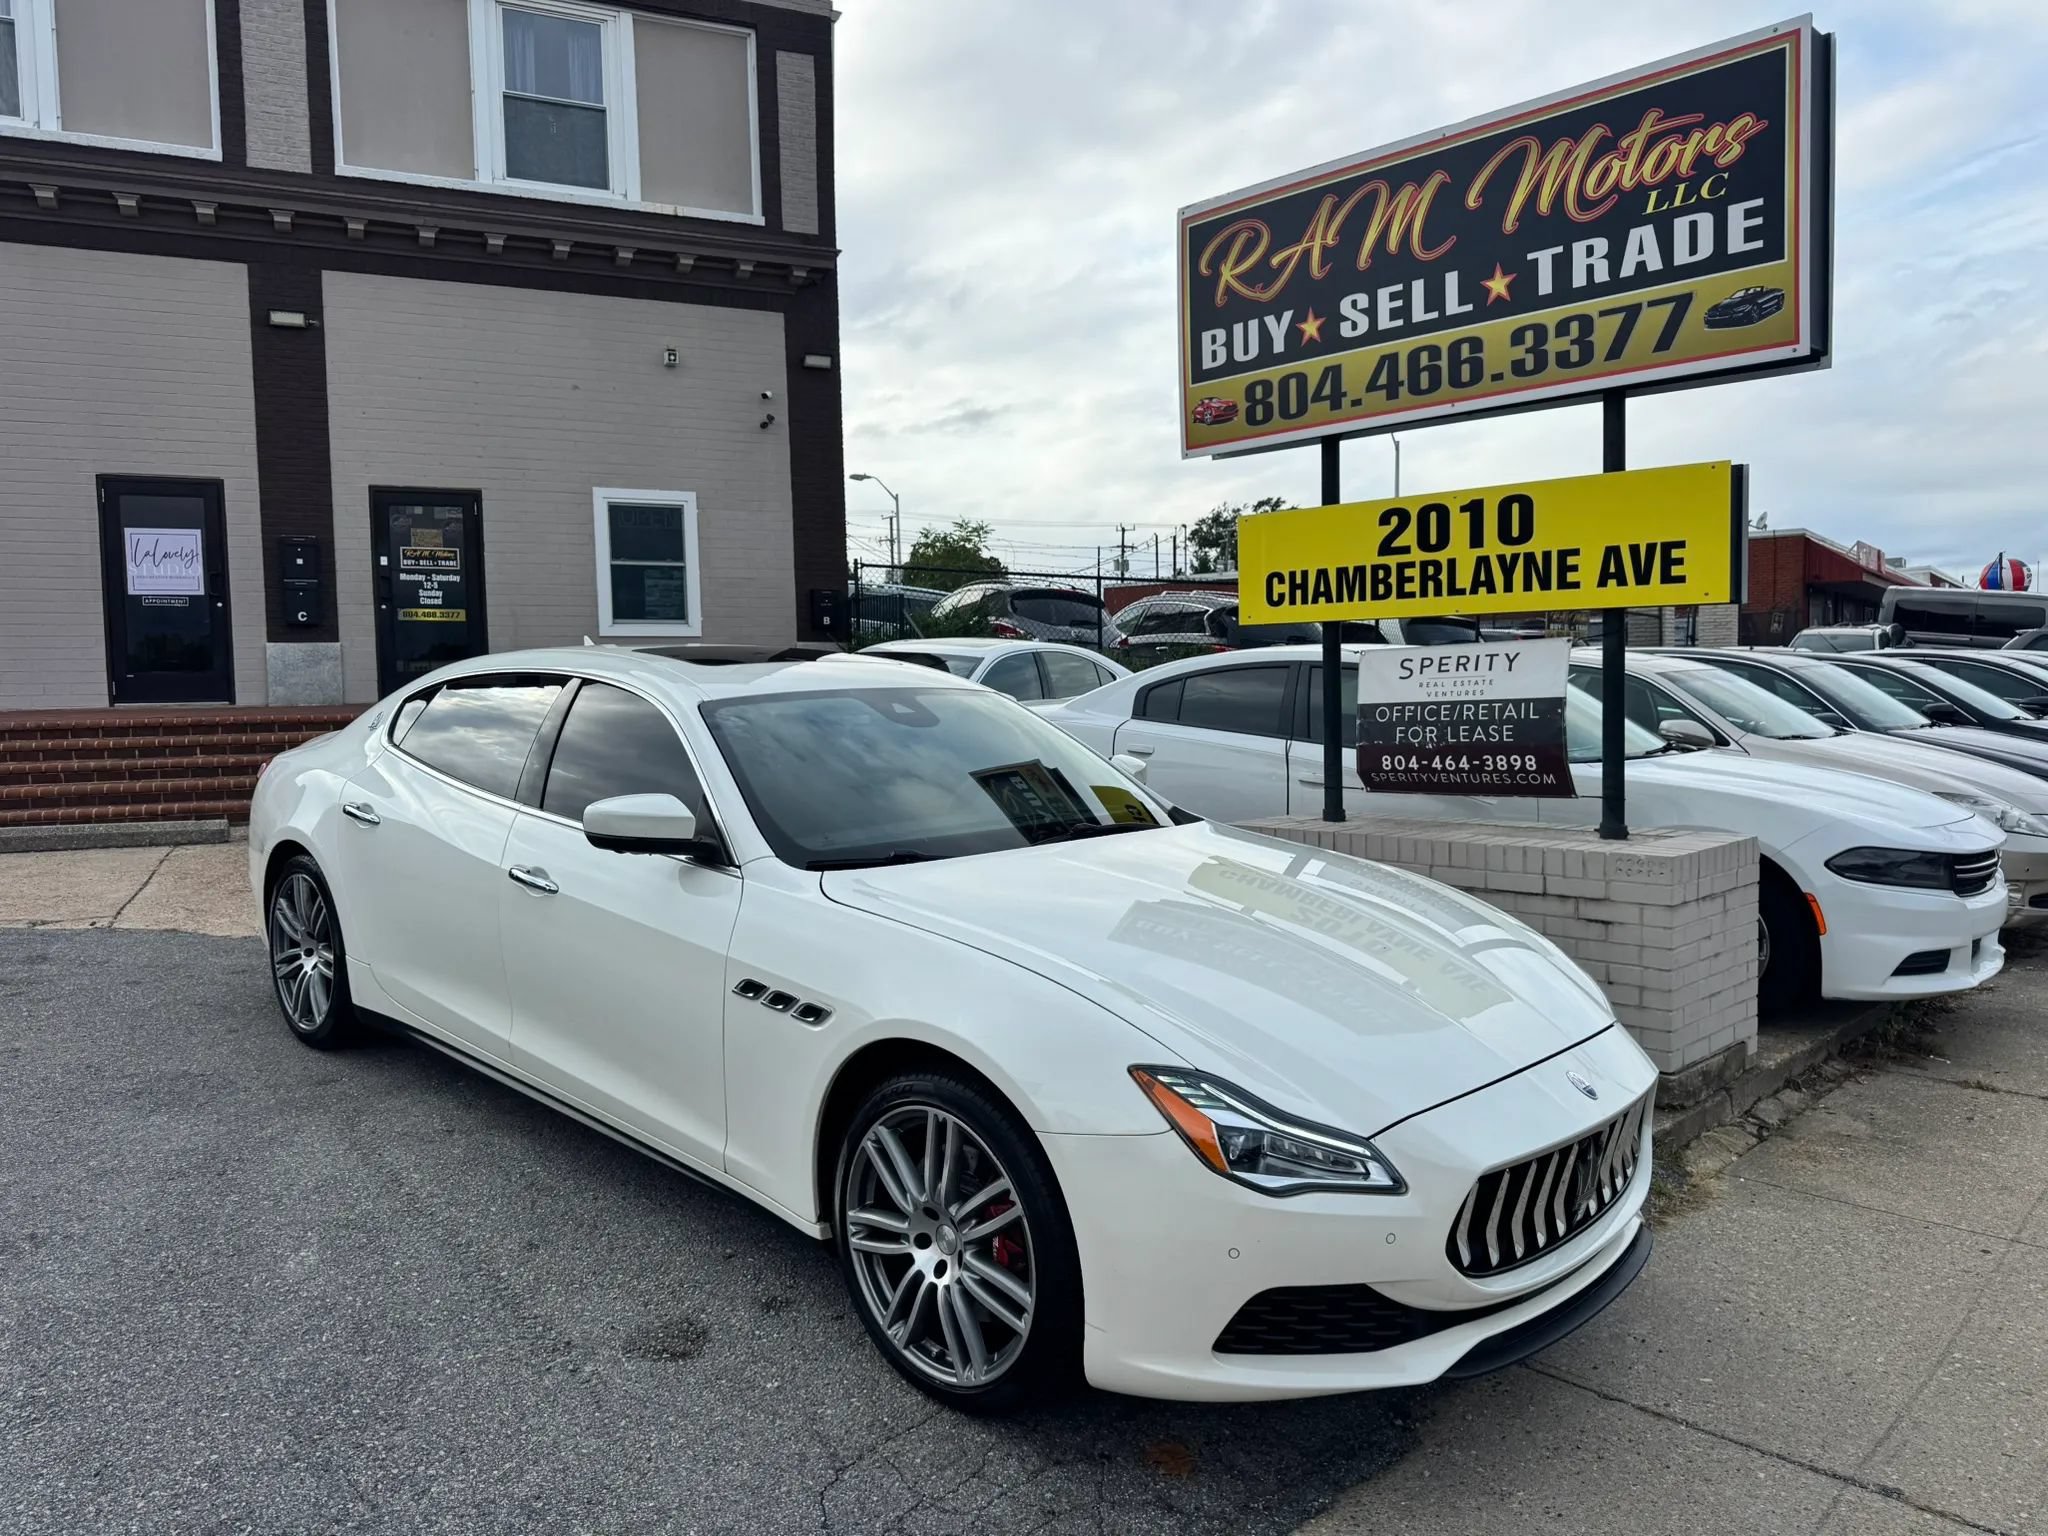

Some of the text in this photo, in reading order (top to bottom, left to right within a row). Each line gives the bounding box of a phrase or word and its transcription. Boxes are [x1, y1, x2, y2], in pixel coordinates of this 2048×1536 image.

[1642, 172, 1730, 215] LLC
[1199, 108, 1768, 308] RAM Motors
[1201, 197, 1764, 371] BUY SELL TRADE
[1244, 292, 1695, 427] 804.466.3377
[1377, 493, 1534, 557] 2010
[400, 573, 426, 581] Monday
[431, 574, 460, 582] Saturday
[1265, 540, 1687, 608] CHAMBERLAYNE AVE
[418, 589, 443, 597] Sunday
[419, 597, 443, 605] Closed
[297, 611, 308, 621] C
[823, 616, 831, 625] B
[1399, 652, 1521, 680] SPERITY
[1453, 679, 1494, 687] ESTATE
[1426, 689, 1485, 698] VENTURES
[1375, 702, 1540, 722] OFFICE/RETAIL
[1395, 725, 1515, 744] FOR LEASE
[1381, 755, 1537, 771] 804-464-3898
[1371, 772, 1557, 785] SPERITYVENTURES.COM
